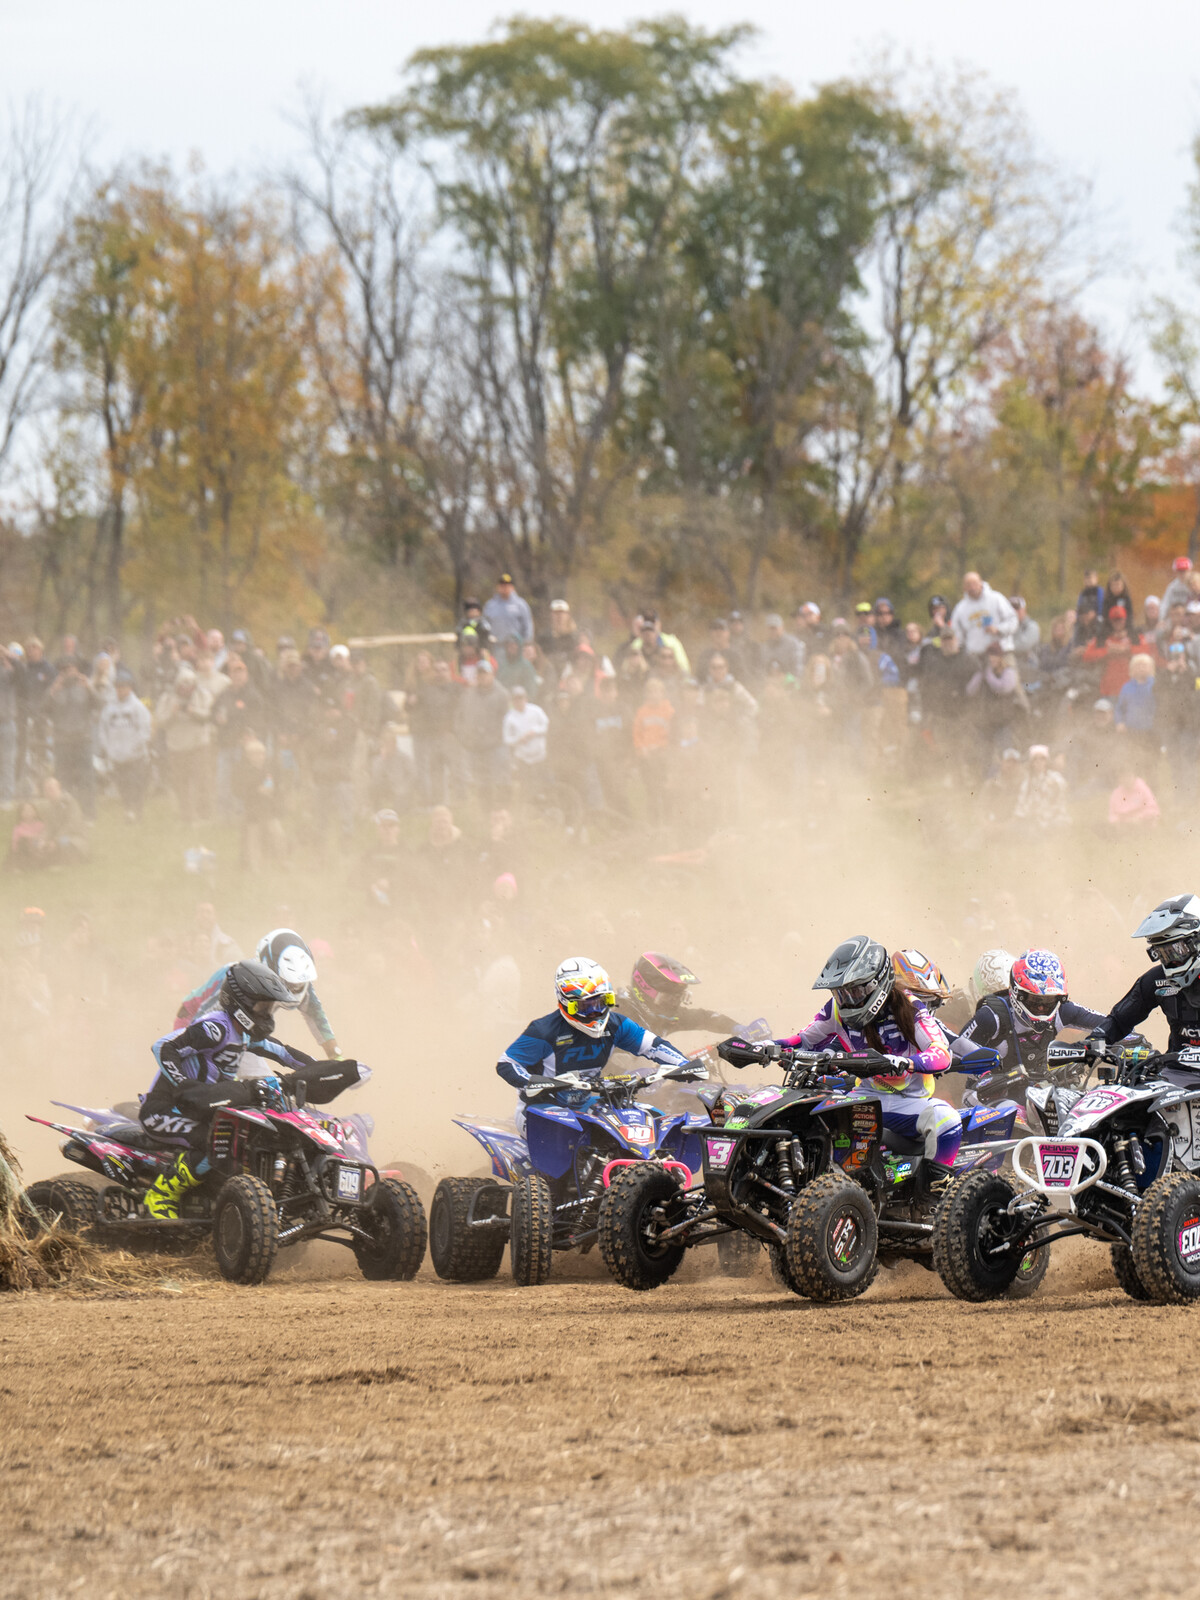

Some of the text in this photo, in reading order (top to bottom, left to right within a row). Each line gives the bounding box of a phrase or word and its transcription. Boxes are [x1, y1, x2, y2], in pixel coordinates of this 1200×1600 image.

[871, 992, 887, 1014] 003
[236, 1011, 252, 1028] 609
[563, 1044, 606, 1063] FLY
[1077, 1096, 1114, 1111] 703
[976, 1111, 1001, 1123] MAXXIS
[628, 1127, 651, 1139] 10
[709, 1142, 732, 1163] 3
[1043, 1156, 1074, 1178] 703
[339, 1170, 360, 1196] 609
[556, 1196, 594, 1211] WALSH
